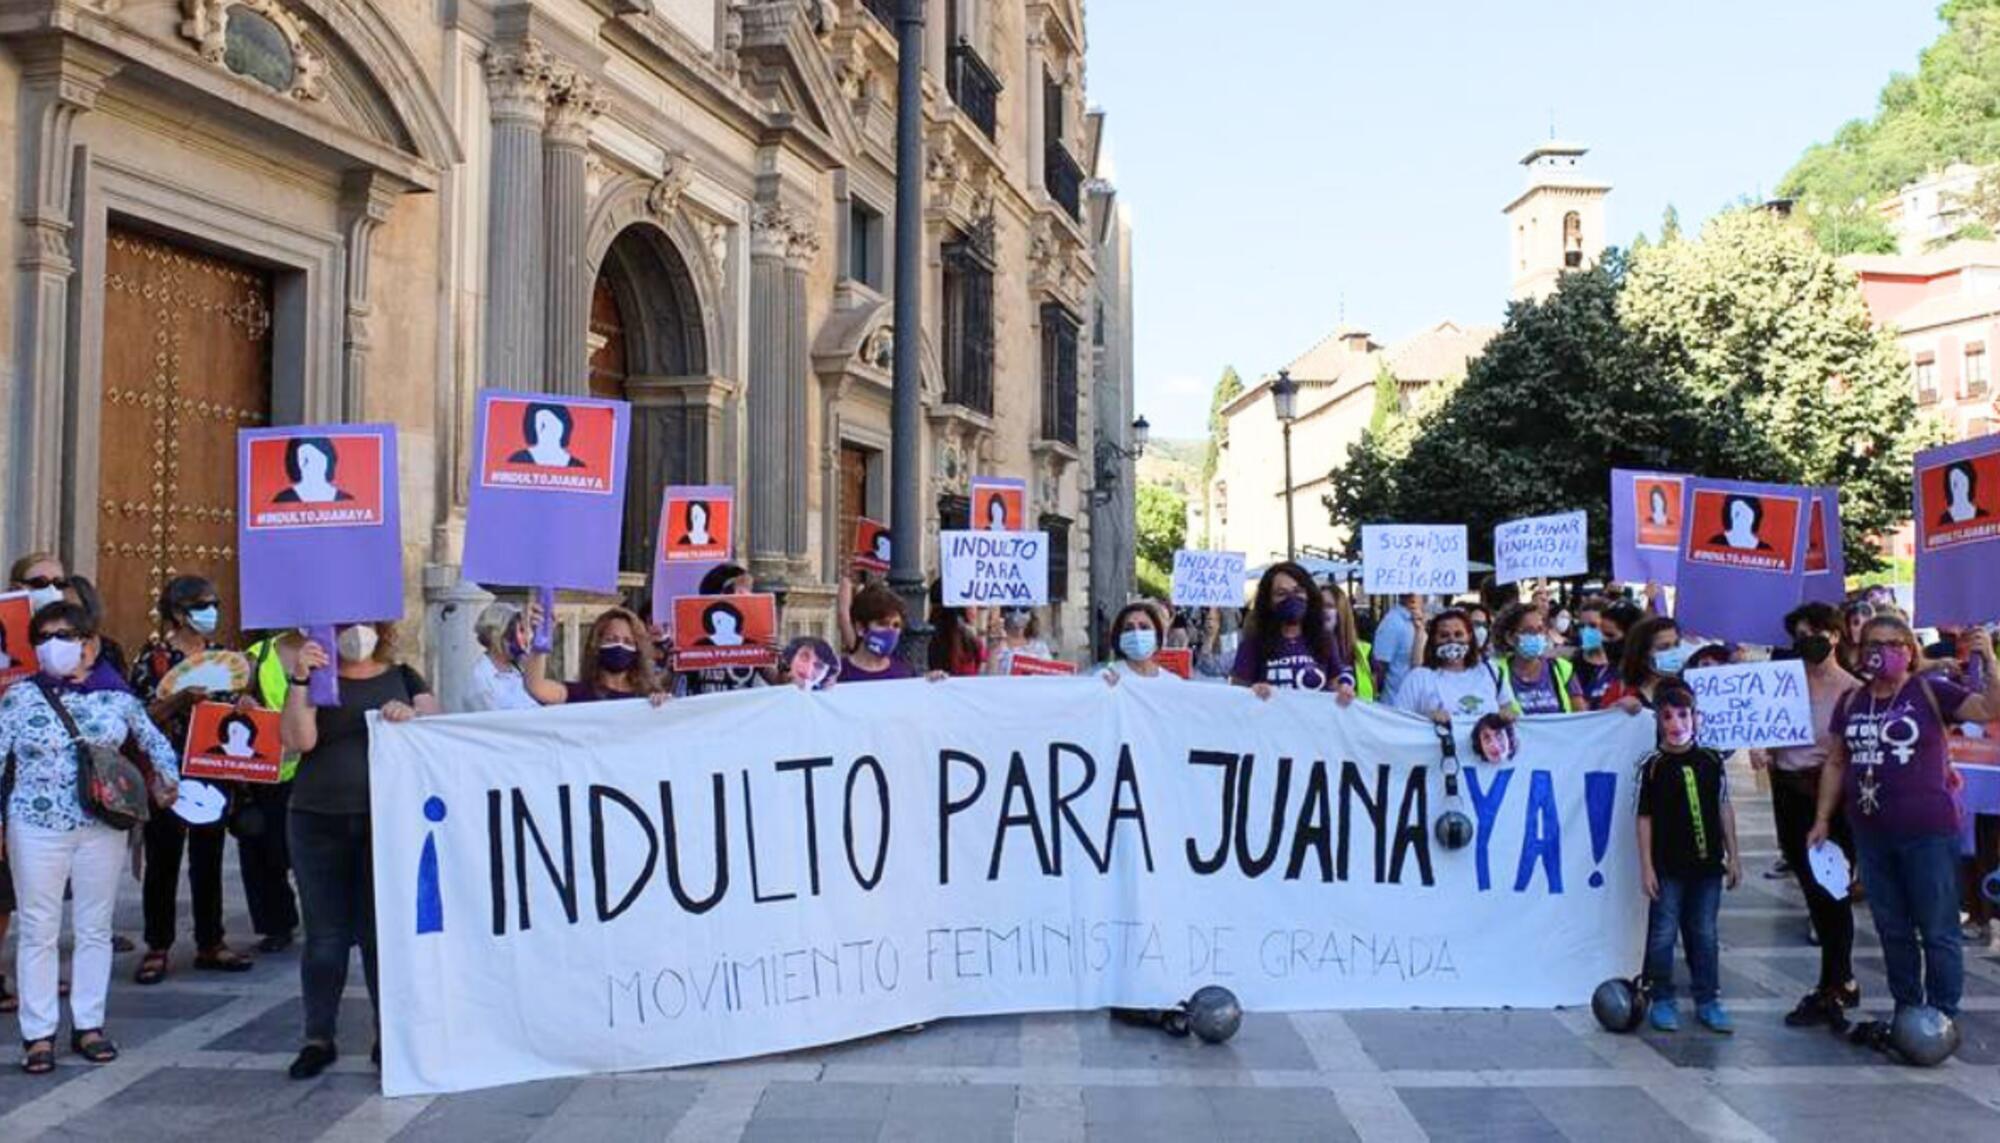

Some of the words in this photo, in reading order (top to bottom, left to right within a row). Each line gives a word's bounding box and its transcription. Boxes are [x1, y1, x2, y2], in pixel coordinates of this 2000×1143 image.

[953, 536, 1038, 560] INDULTO
[975, 559, 1022, 580] PARA
[1178, 552, 1242, 574] INDULTO
[1187, 569, 1230, 587] PARA
[1375, 568, 1457, 588] PELIGRO
[960, 580, 1032, 601] JUANA
[1176, 583, 1233, 602] JUANA
[1693, 671, 1765, 697] BASTA
[1774, 669, 1799, 698] YA
[1696, 706, 1791, 727] JUSTICIA
[938, 741, 1155, 886] PARA
[1185, 749, 1435, 887] JUANA
[1462, 766, 1618, 895] YA!
[925, 916, 1169, 982] FEMINISTA
[1187, 924, 1237, 976] DE
[1259, 928, 1460, 982] GRANADA
